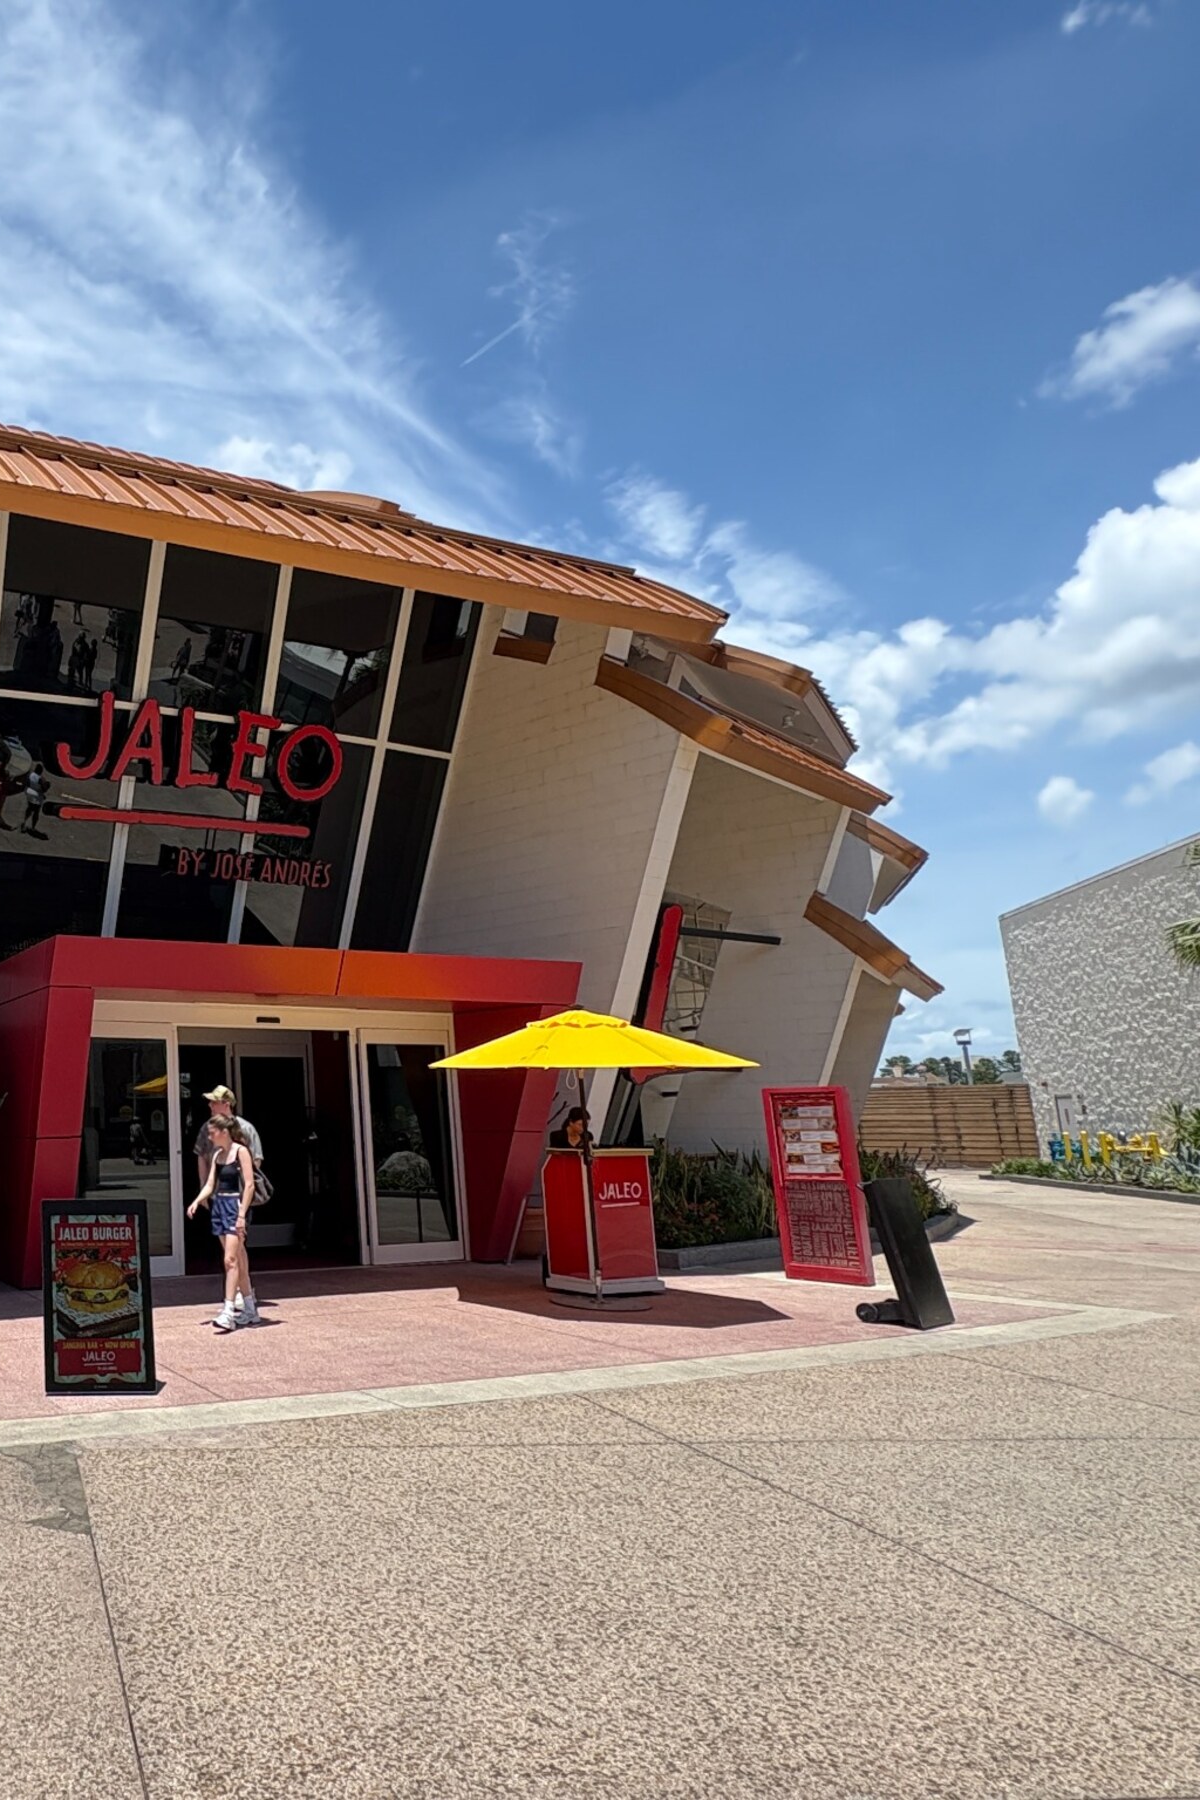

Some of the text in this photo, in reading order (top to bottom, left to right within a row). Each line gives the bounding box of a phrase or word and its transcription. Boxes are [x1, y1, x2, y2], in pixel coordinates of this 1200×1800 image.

[56, 691, 343, 801] JALEO
[177, 848, 331, 888] BY JOSÉ ANDRÉS
[599, 1182, 642, 1200] JALEO
[58, 1226, 133, 1241] JALEO BURGER
[81, 1350, 116, 1362] JALEO
